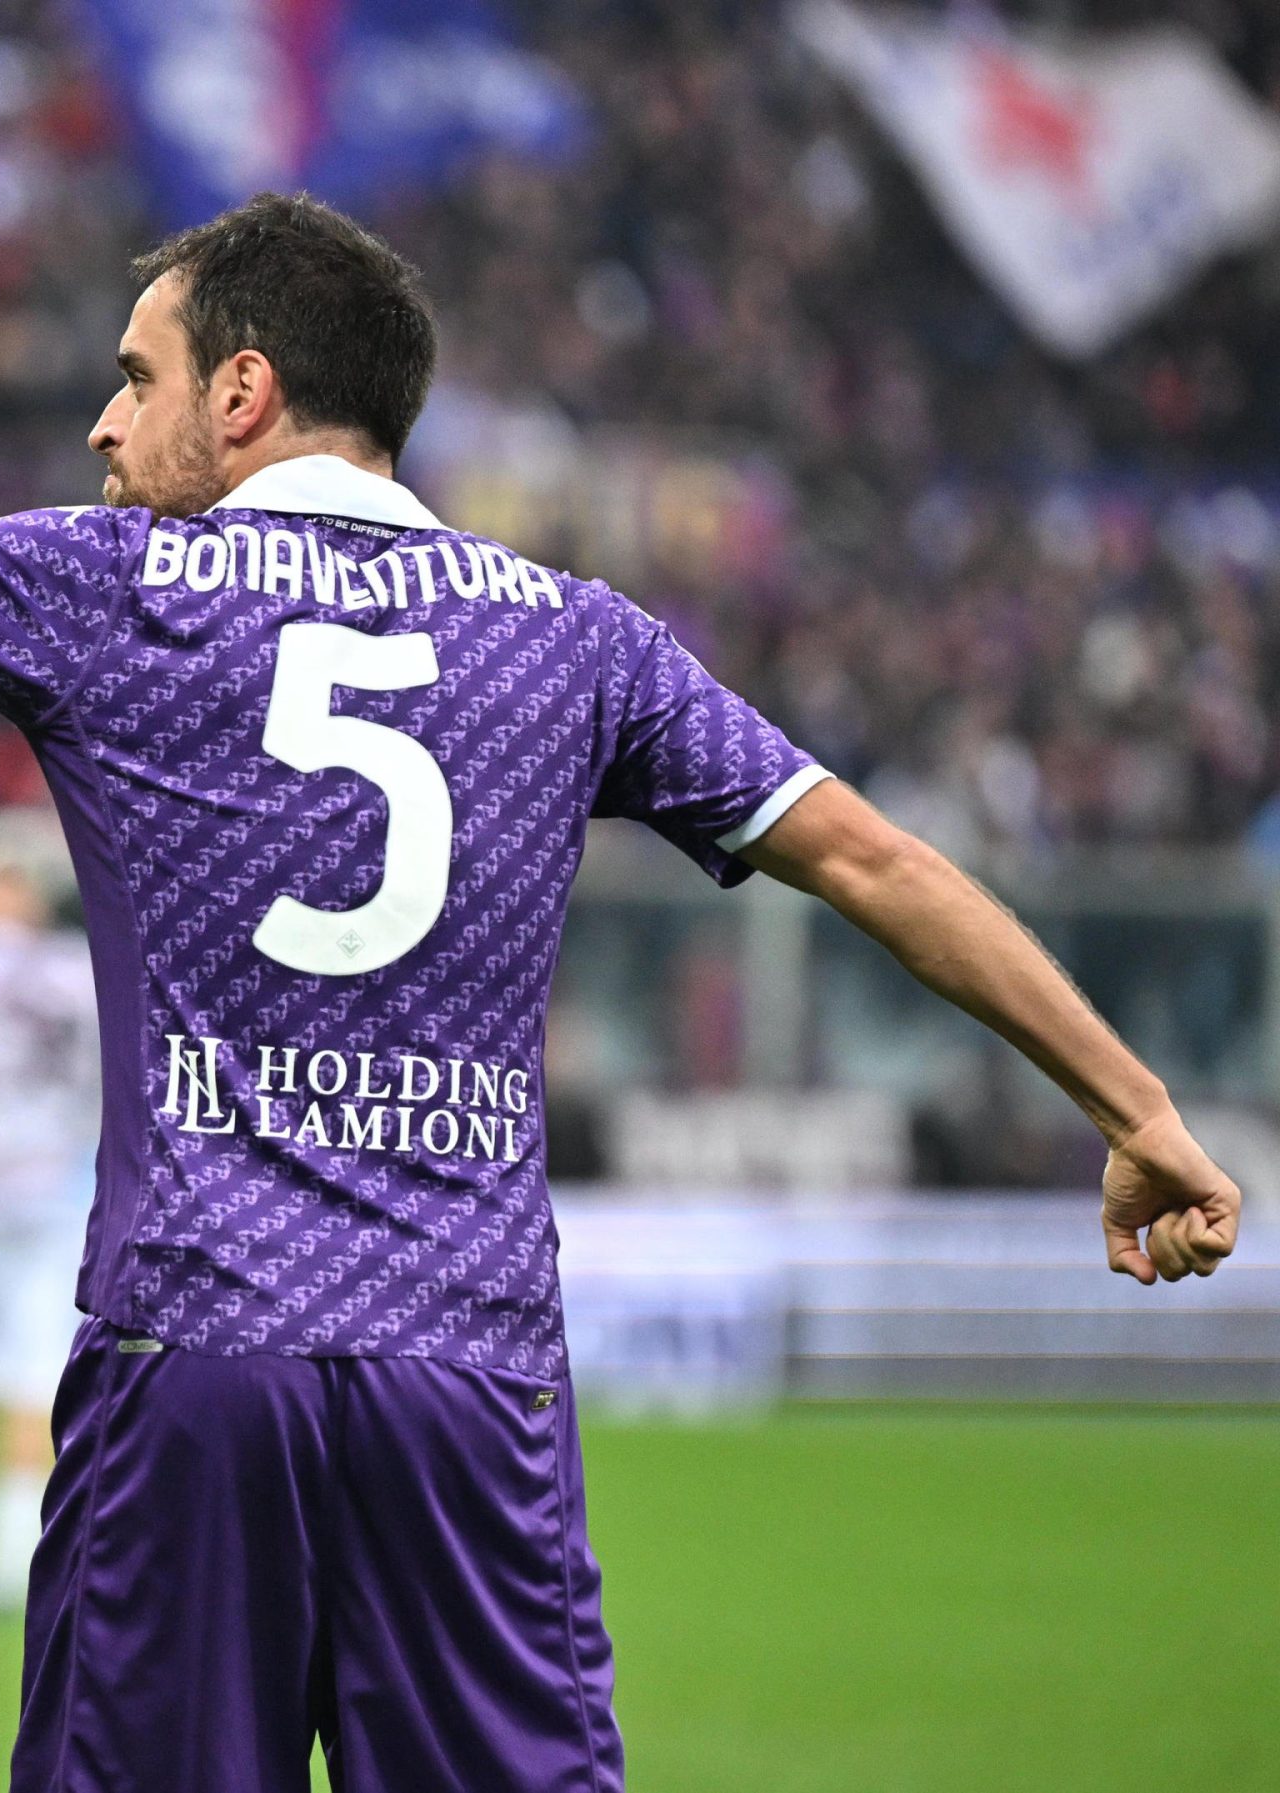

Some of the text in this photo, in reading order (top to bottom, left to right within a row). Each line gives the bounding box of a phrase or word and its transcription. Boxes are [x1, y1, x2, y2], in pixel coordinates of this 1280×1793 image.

[321, 516, 334, 526] TO
[335, 519, 349, 530] BE
[142, 524, 563, 610] BONAVENTURA
[252, 622, 453, 976] 5
[256, 1045, 528, 1114] HOLDING
[255, 1095, 521, 1163] LAMIONI
